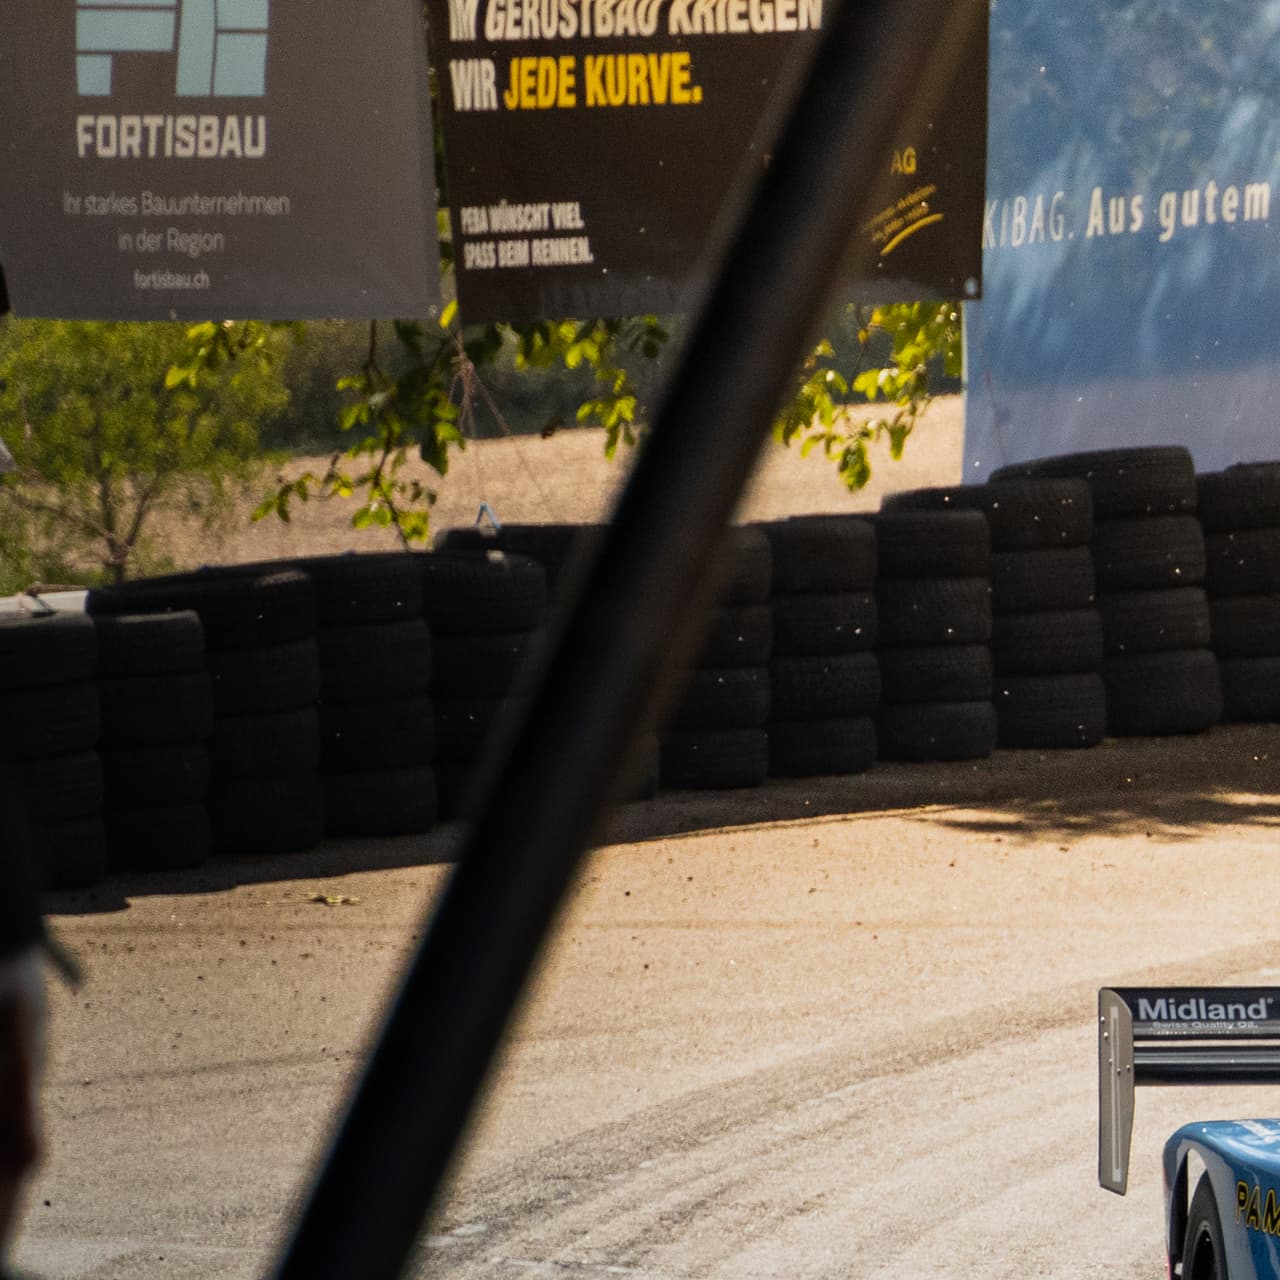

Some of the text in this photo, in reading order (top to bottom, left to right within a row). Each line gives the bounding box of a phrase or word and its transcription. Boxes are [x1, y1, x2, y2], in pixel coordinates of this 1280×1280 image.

[450, 51, 704, 112] WIR JEDE KURVE.
[76, 114, 267, 159] FORTISBAU
[84, 192, 138, 216] starkes
[141, 190, 291, 216] Bauunternehmen
[1086, 186, 1144, 238] Aus
[1159, 180, 1271, 243] gutem
[118, 228, 225, 259] in der Region
[1138, 998, 1269, 1021] Midland
[1153, 1021, 1190, 1031] Swiss
[1192, 1021, 1235, 1032] Quality
